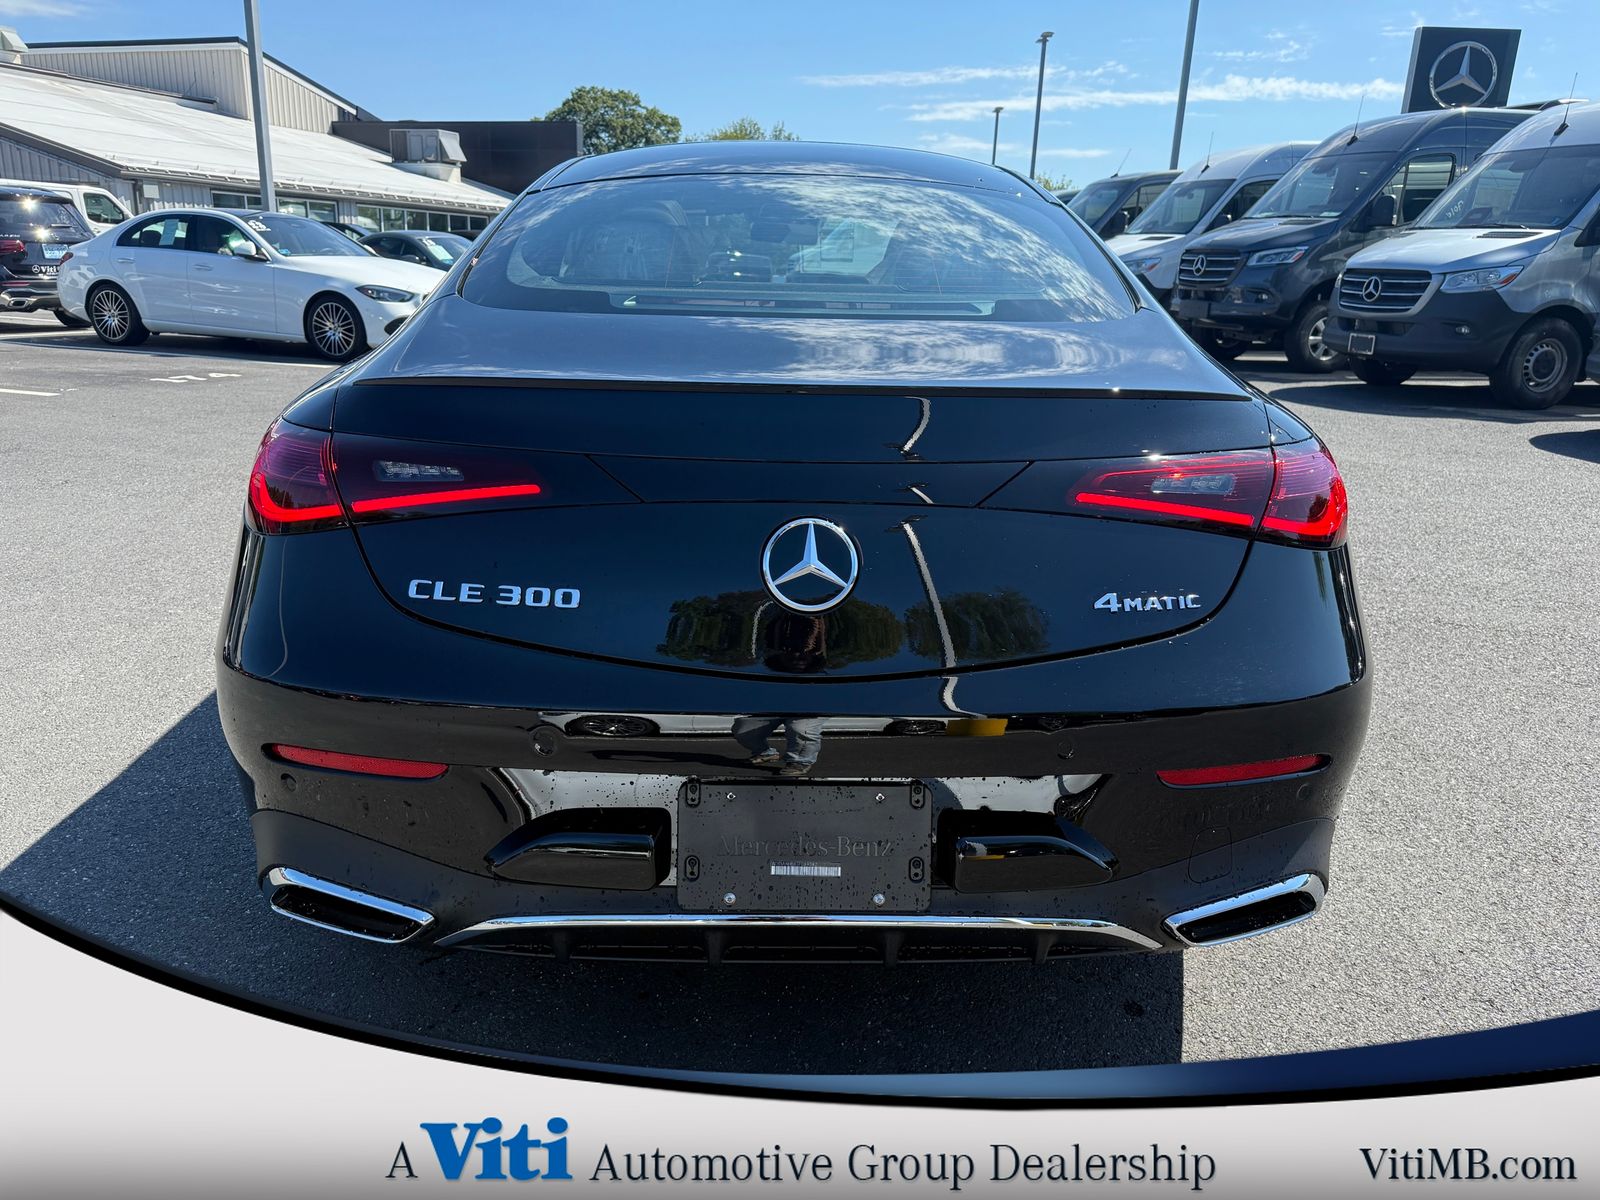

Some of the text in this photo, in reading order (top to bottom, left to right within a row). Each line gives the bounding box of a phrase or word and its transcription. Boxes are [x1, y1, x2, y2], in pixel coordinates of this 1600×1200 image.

[41, 265, 57, 273] Viti
[408, 579, 580, 608] CLE 300
[1094, 592, 1202, 613] 4MATIC
[717, 834, 895, 858] Mercedes-Benz
